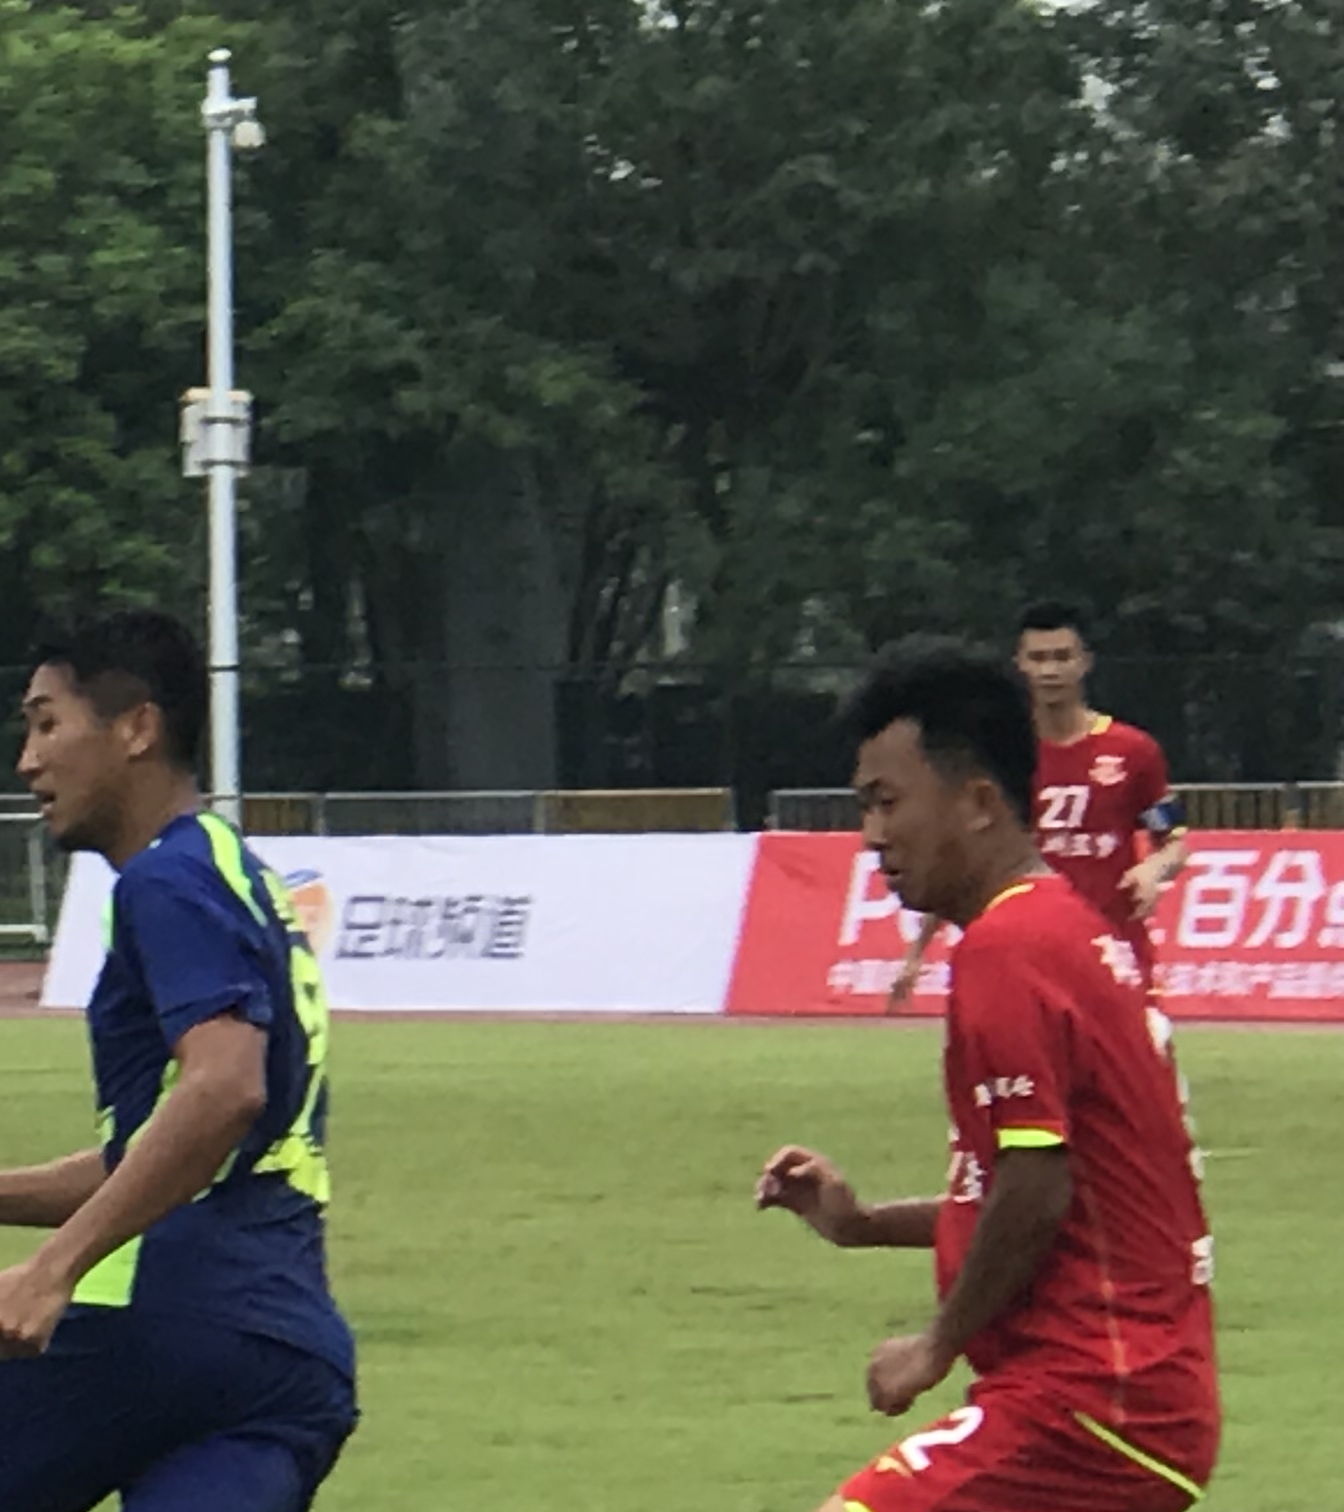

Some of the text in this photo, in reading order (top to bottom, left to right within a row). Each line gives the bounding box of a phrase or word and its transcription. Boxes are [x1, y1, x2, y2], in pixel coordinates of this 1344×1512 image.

[1038, 785, 1090, 829] 27
[335, 895, 531, 960] 足球频道
